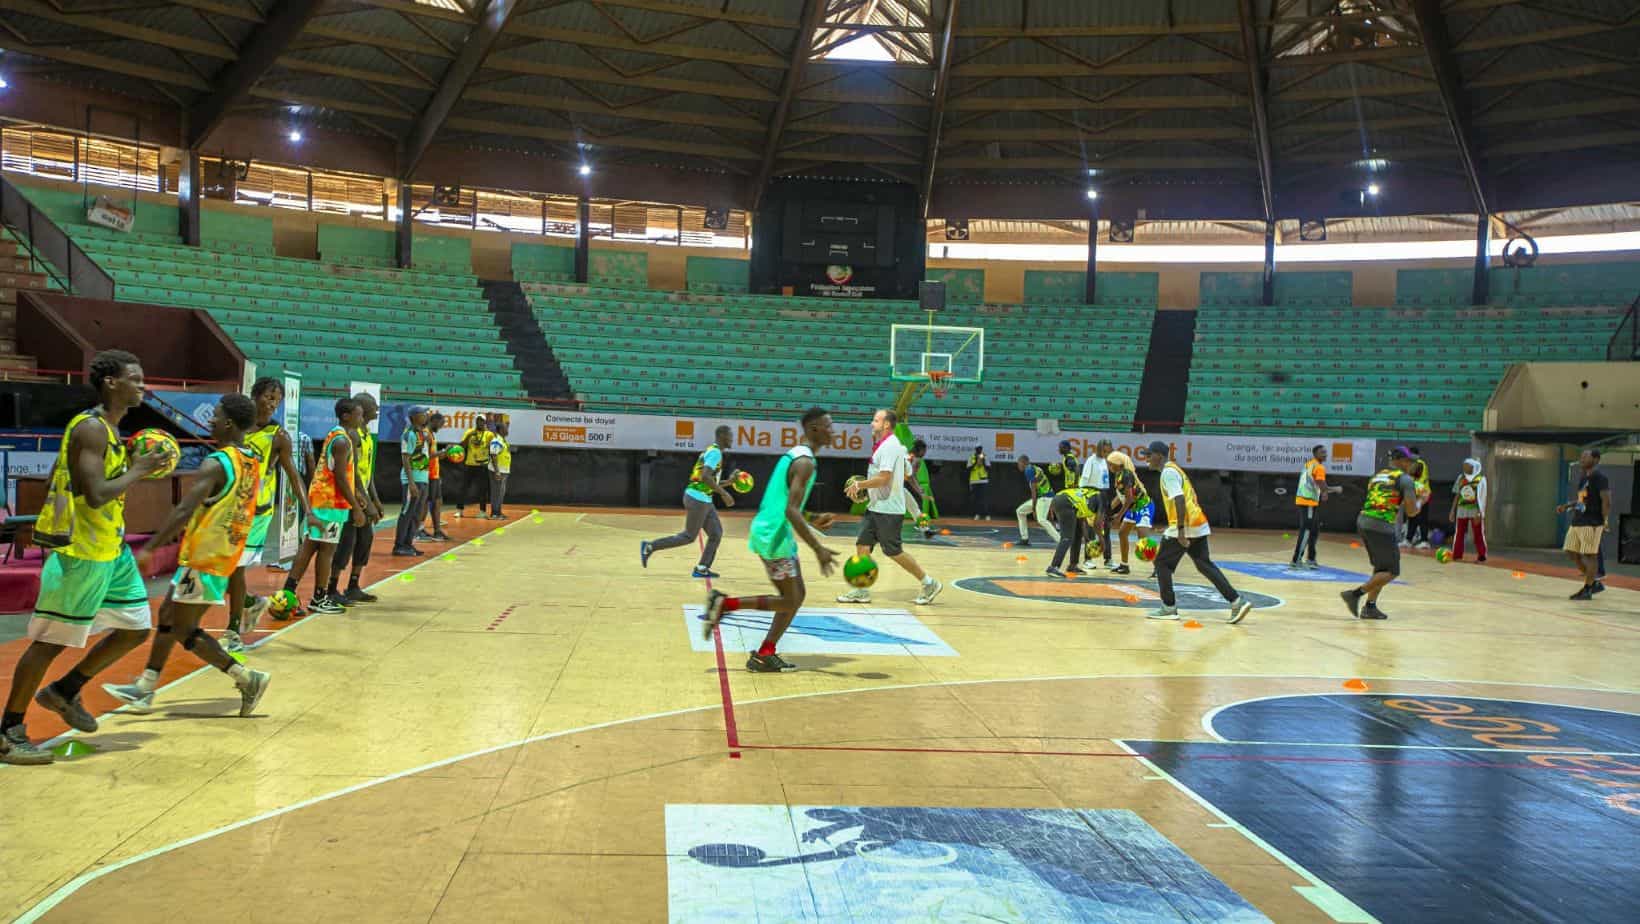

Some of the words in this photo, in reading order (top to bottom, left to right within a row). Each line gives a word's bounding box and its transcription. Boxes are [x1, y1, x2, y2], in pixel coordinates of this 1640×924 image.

[587, 432, 604, 441] 500
[605, 433, 612, 442] F
[737, 424, 772, 447] Na
[1276, 446, 1313, 455] supporte
